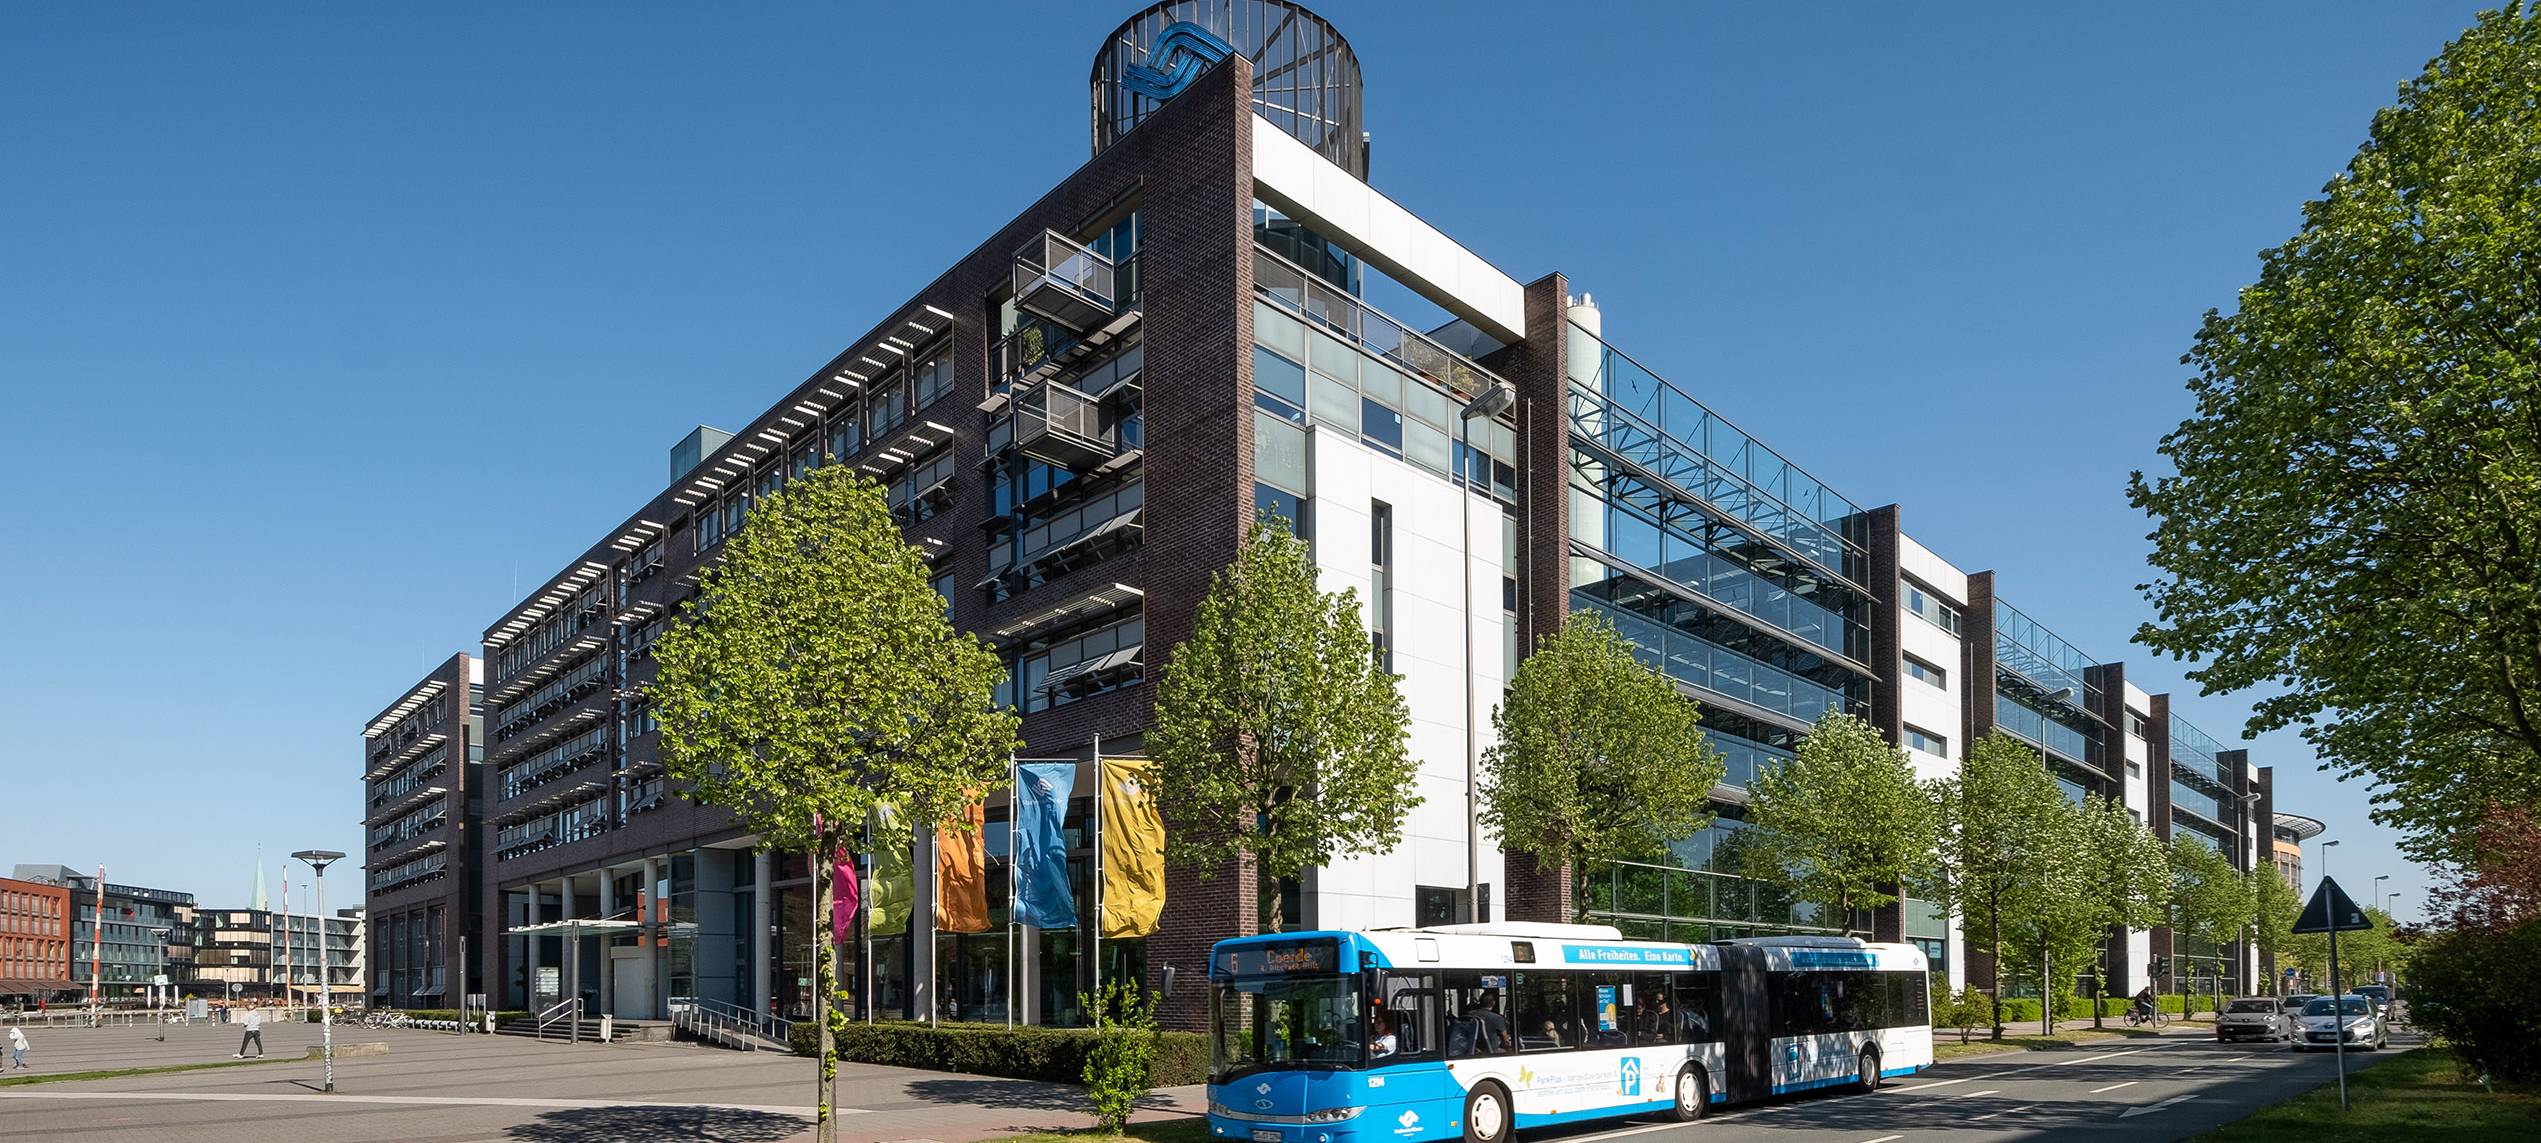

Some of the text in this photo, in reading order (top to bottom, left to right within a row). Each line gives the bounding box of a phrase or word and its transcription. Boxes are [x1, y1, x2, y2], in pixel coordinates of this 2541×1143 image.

[1231, 953, 1239, 976] 6
[1579, 949, 1686, 962] Alle Freiheiten. Eine Karte.
